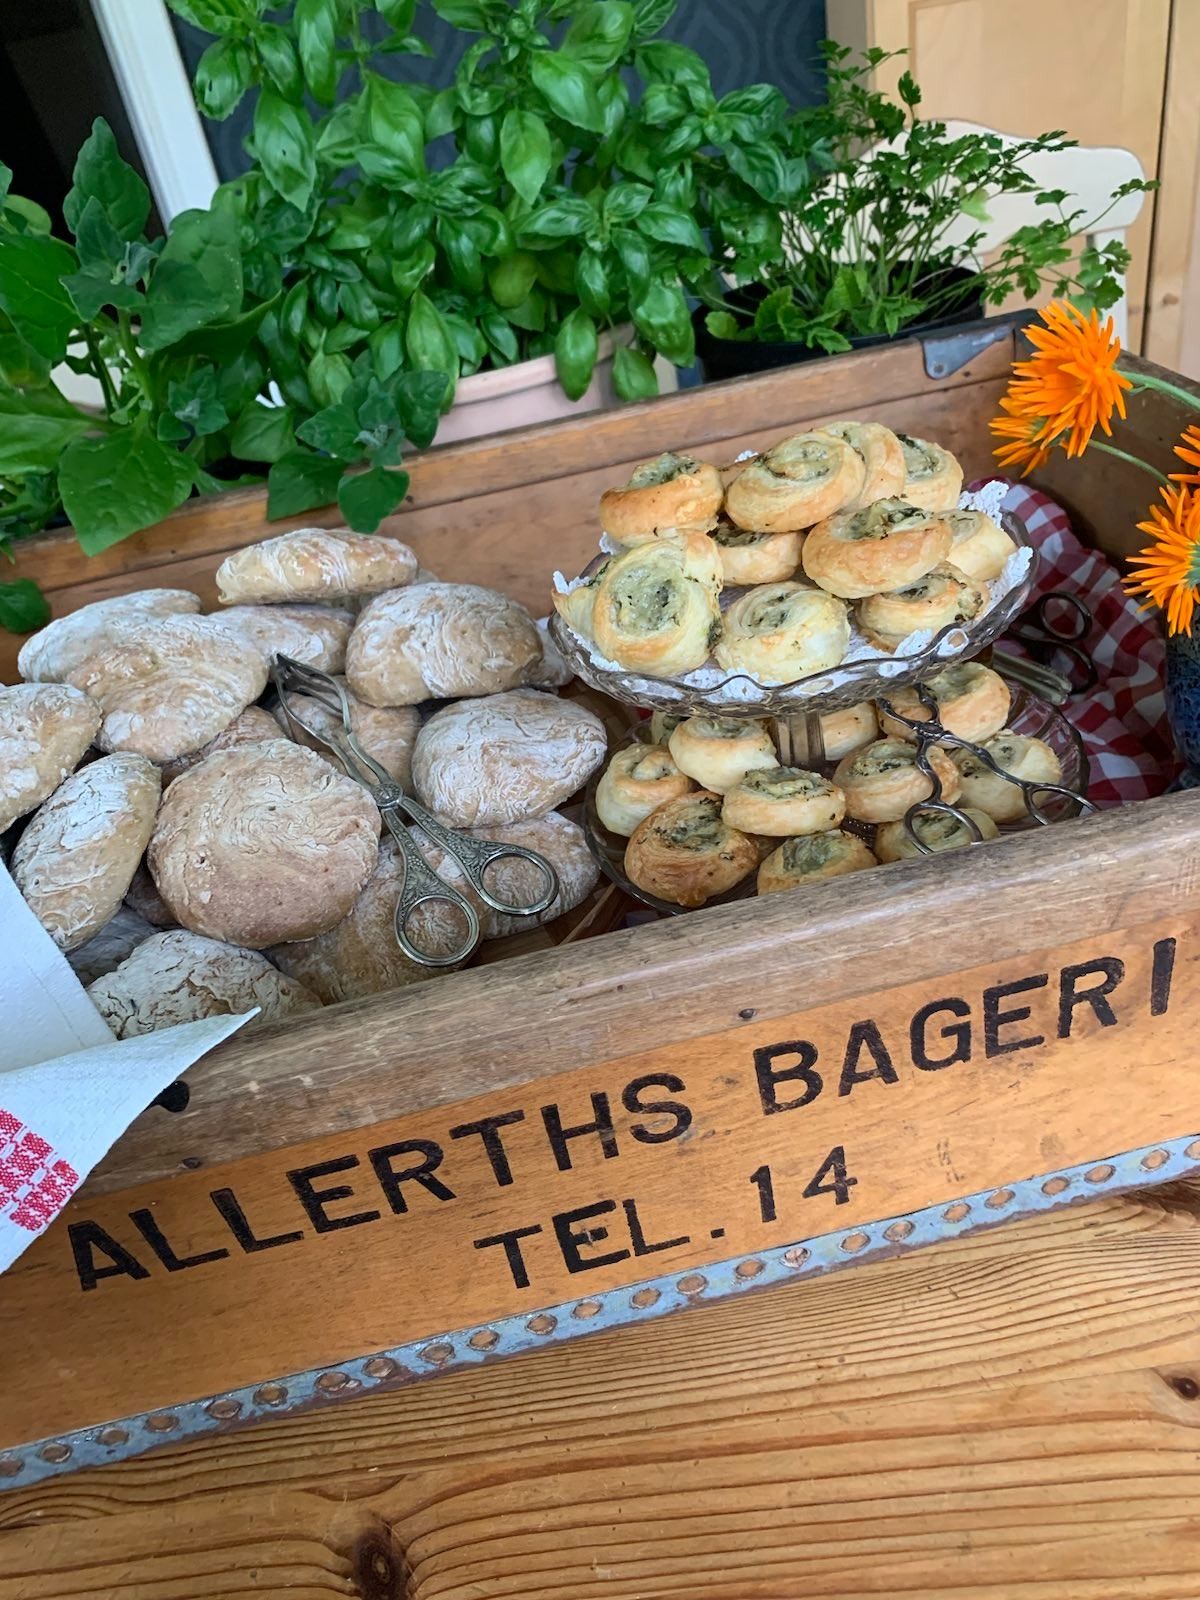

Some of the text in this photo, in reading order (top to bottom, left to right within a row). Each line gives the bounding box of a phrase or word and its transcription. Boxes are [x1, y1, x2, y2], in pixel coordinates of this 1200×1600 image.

[67, 937, 1176, 1291] ALLERTHS BAGERI
[473, 1145, 858, 1289] TEL. 14
